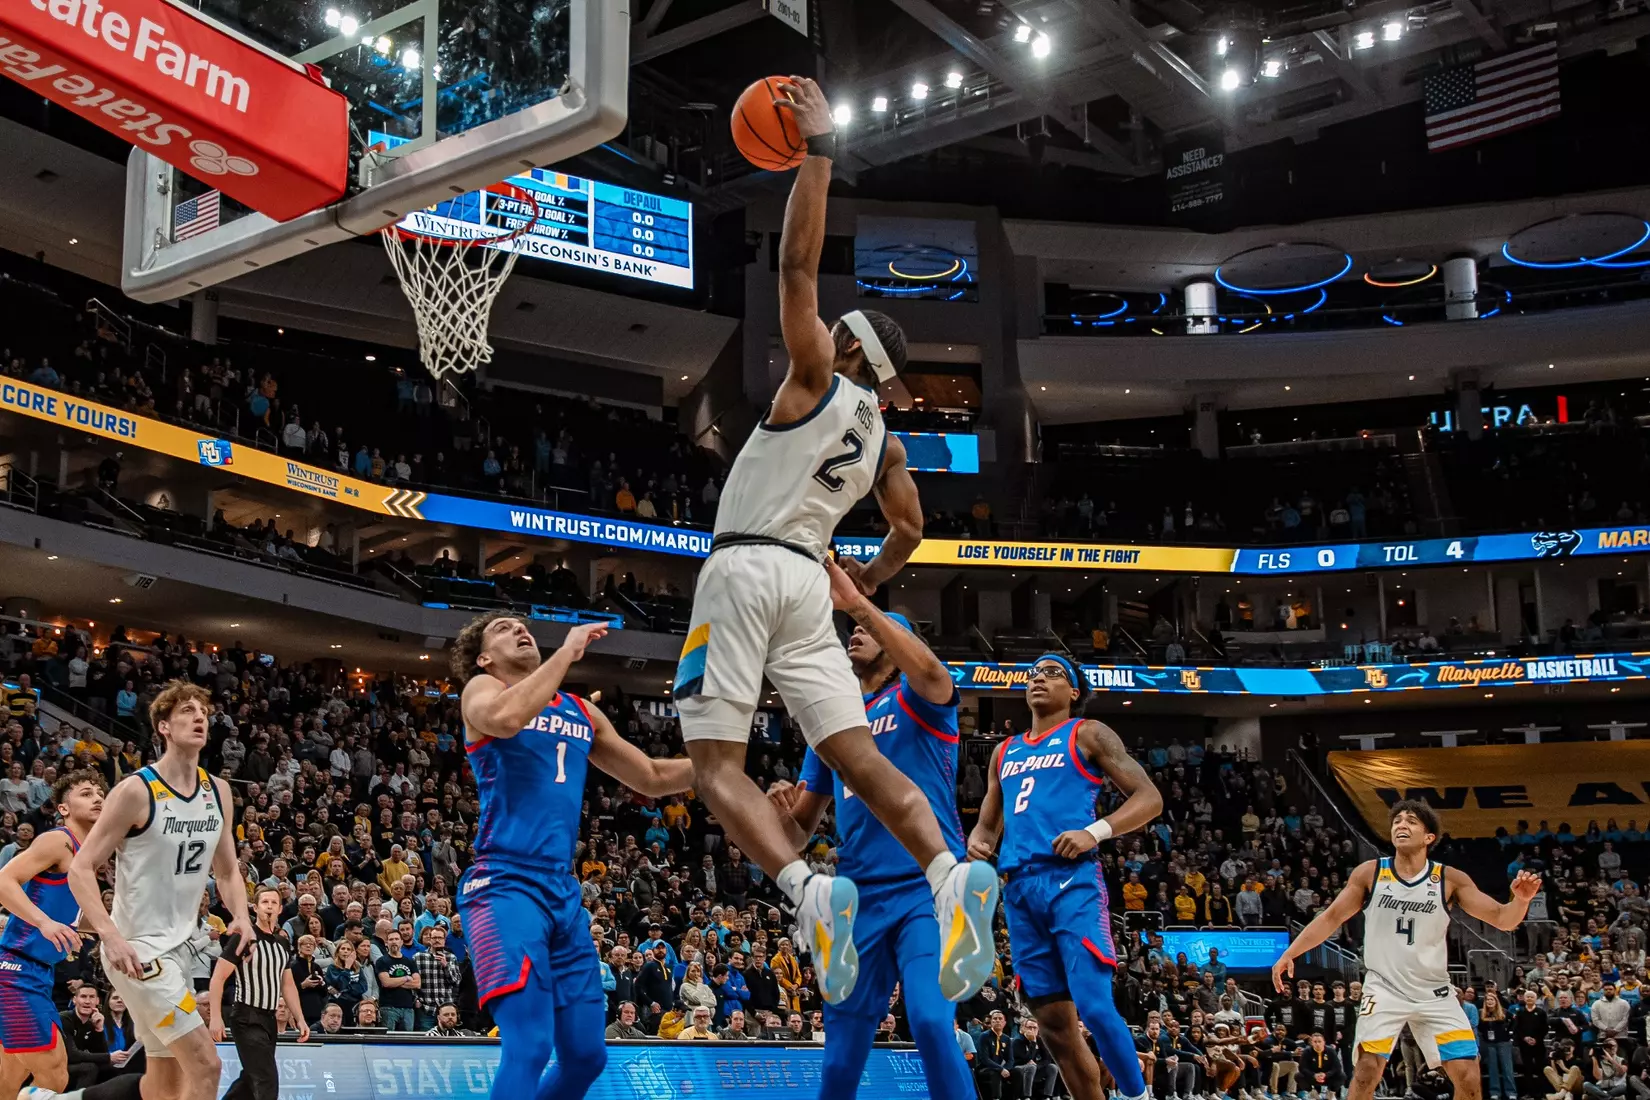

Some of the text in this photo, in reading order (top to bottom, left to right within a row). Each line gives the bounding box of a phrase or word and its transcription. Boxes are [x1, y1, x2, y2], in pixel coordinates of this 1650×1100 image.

[133, 17, 250, 113] Farm
[1166, 154, 1223, 180] ASSISTANCE?
[1183, 148, 1206, 163] NEED
[534, 191, 556, 205] GOAL
[623, 191, 663, 212] DEPAUL
[520, 203, 544, 217] FIED
[544, 209, 566, 223] GOAL
[632, 212, 654, 226] 0.0
[632, 227, 654, 241] 0.0
[512, 238, 609, 268] WISCONSIN'S
[632, 243, 654, 257] 0.0
[0, 384, 137, 438] CORE YOURS!
[812, 427, 865, 493] 2
[286, 462, 340, 488] WINTRUST
[957, 545, 1141, 564] LOSE YOURSELF IN THE FIGHT
[1258, 530, 1650, 569] FLS 0 TOL 4 MAR
[1437, 663, 1525, 685] Marquette
[1527, 658, 1618, 679] BASKETBALL
[554, 742, 567, 784] 1
[1014, 776, 1036, 814] 2
[163, 815, 220, 837] Marquette
[174, 839, 207, 876] 12
[1378, 893, 1438, 914] Marquette
[1395, 916, 1415, 946] 4
[372, 1058, 452, 1095] STAY
